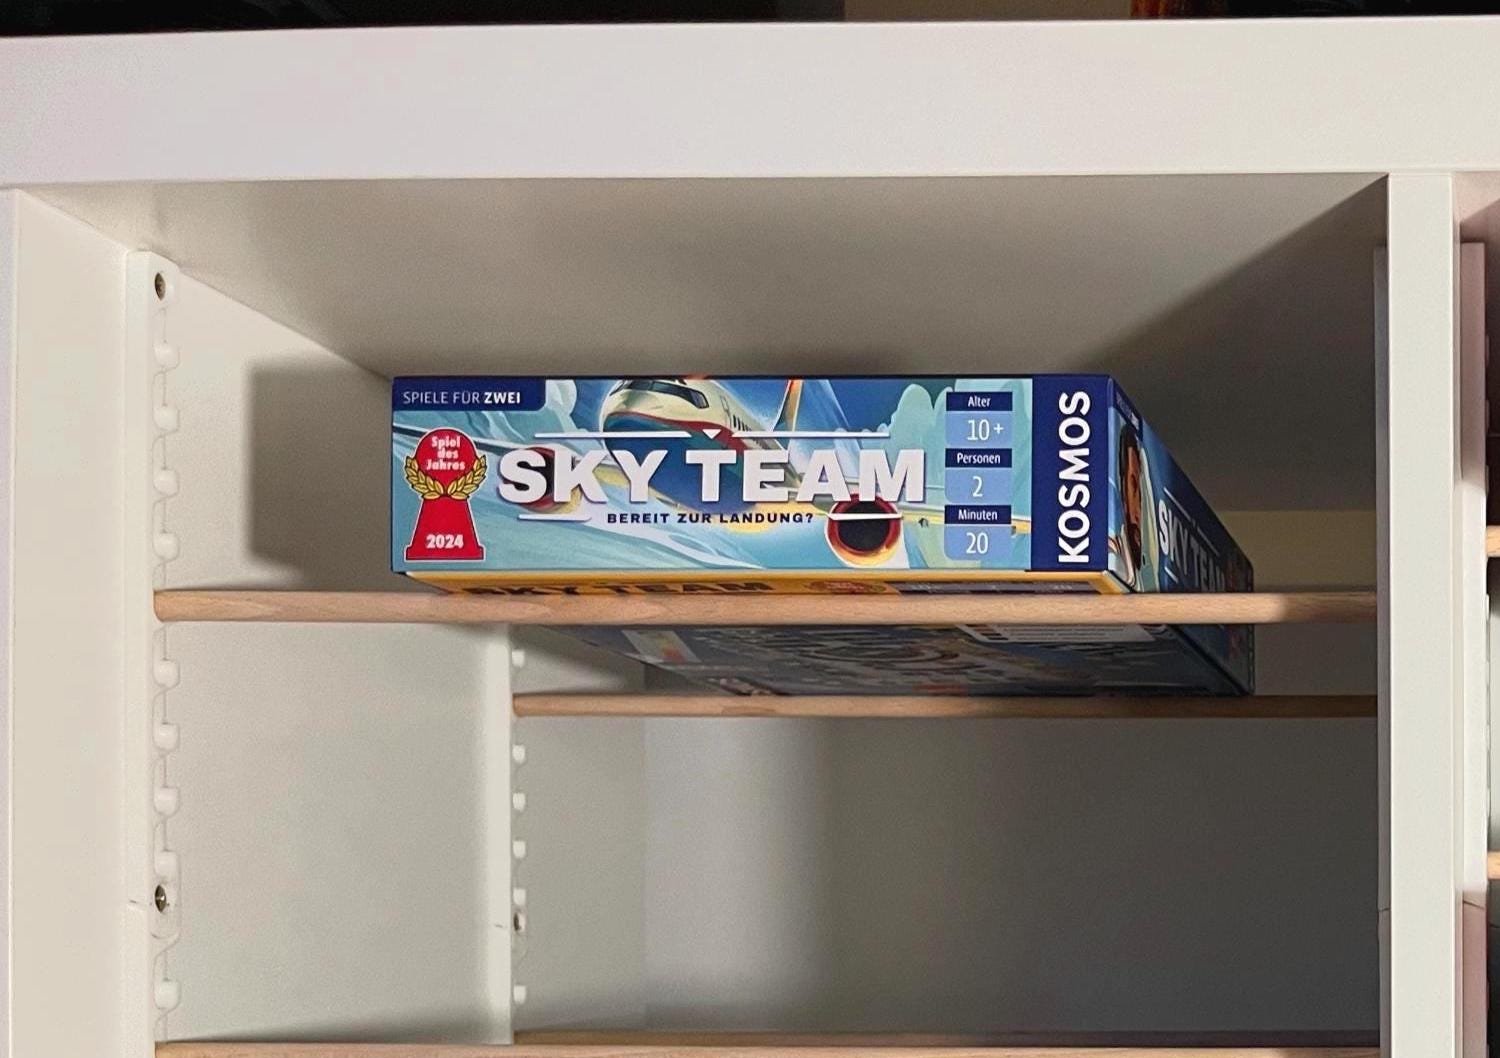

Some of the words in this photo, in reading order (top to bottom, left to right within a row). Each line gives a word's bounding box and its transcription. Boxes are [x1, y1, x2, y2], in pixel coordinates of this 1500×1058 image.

[403, 391, 448, 404] SPIELE
[453, 390, 480, 404] FÜR
[484, 392, 521, 404] ZWEI
[967, 396, 991, 408] Alter
[431, 436, 460, 450] Spiel
[437, 447, 458, 459] des
[956, 452, 1001, 465] Personen
[426, 459, 465, 471] Jahres
[499, 449, 669, 503] SKY
[686, 449, 925, 503] TEAM
[1058, 391, 1091, 563] KOSMOS
[972, 475, 983, 498] 2
[607, 513, 669, 525] BEREIT
[677, 513, 711, 525] ZUR
[719, 512, 813, 525] LANDUNG?
[958, 509, 998, 521] Minuten
[426, 534, 464, 549] 2024
[966, 532, 989, 554] 20
[1159, 498, 1188, 576] SKY
